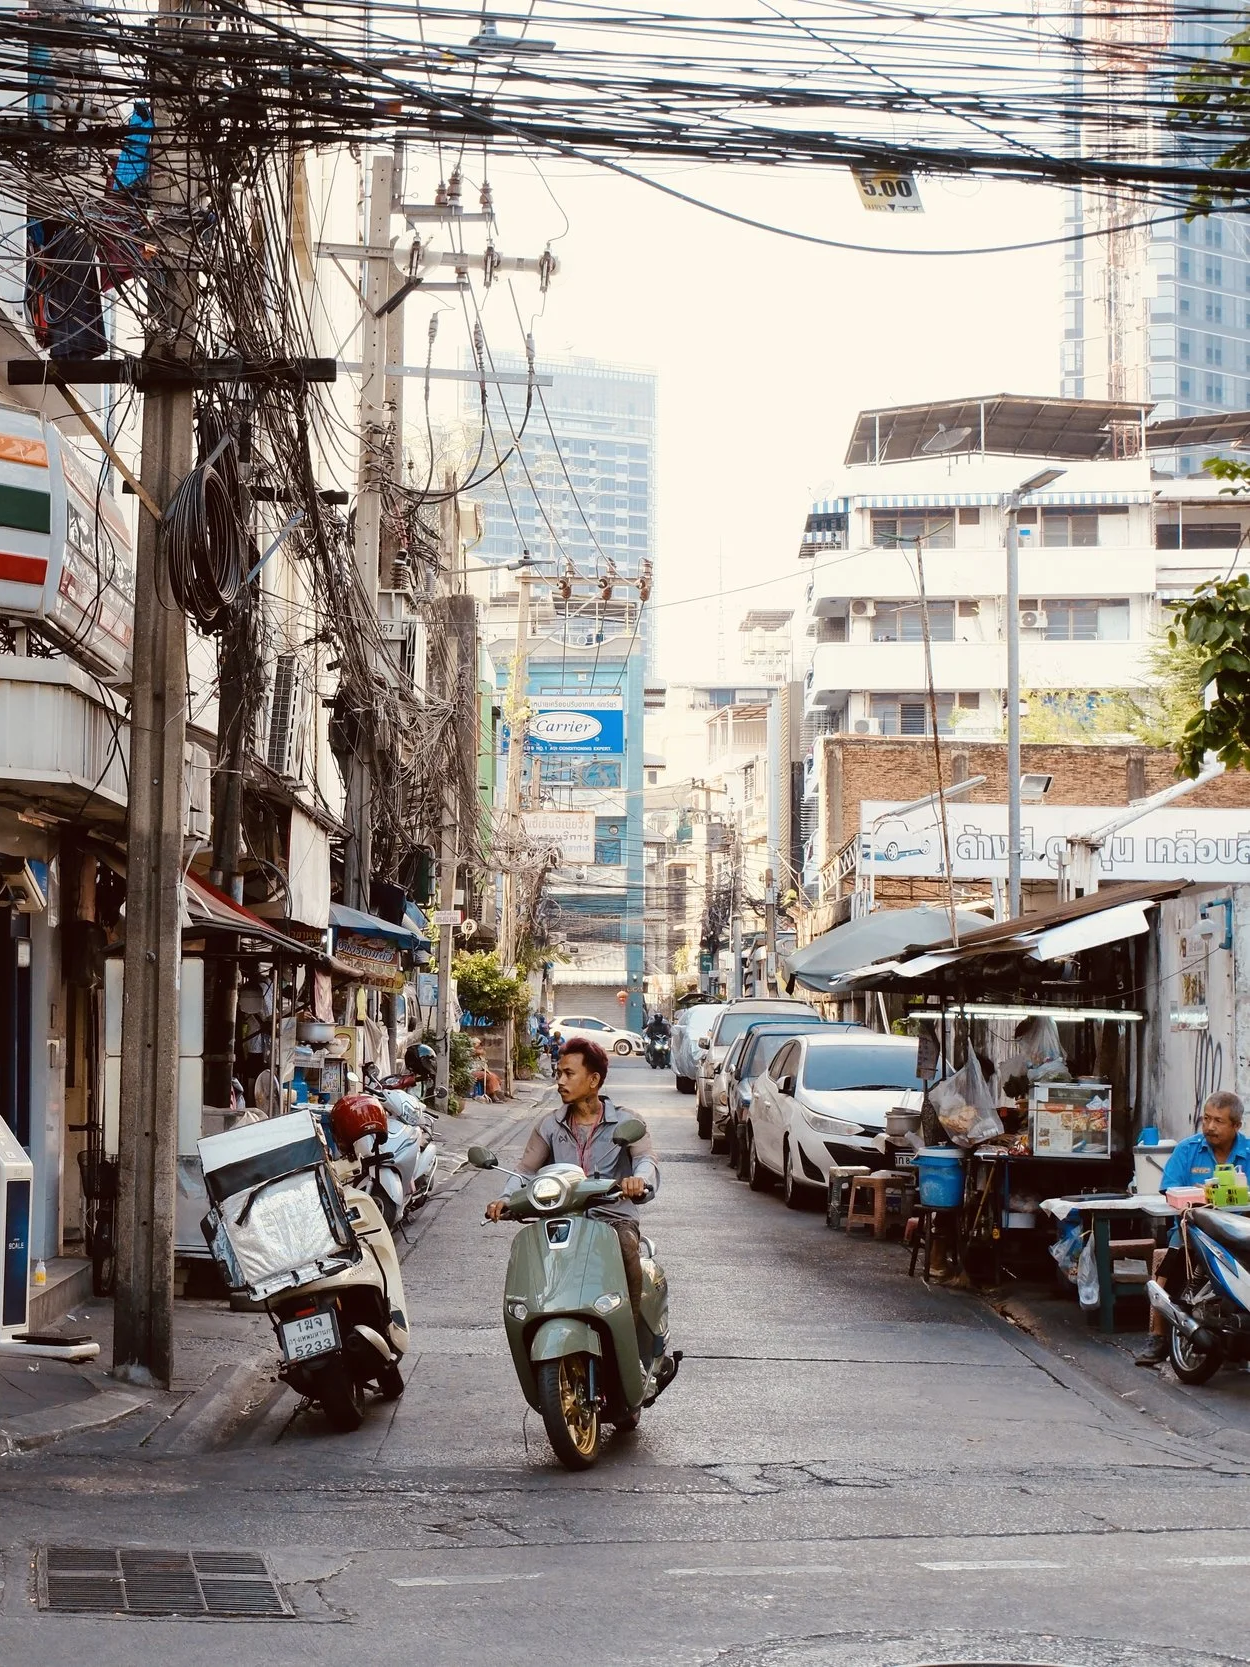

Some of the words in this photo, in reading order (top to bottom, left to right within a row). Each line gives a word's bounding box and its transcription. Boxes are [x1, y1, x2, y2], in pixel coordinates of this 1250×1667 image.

[860, 179, 912, 197] 5.00
[537, 719, 591, 733] Carrier
[295, 1338, 332, 1357] 5233
